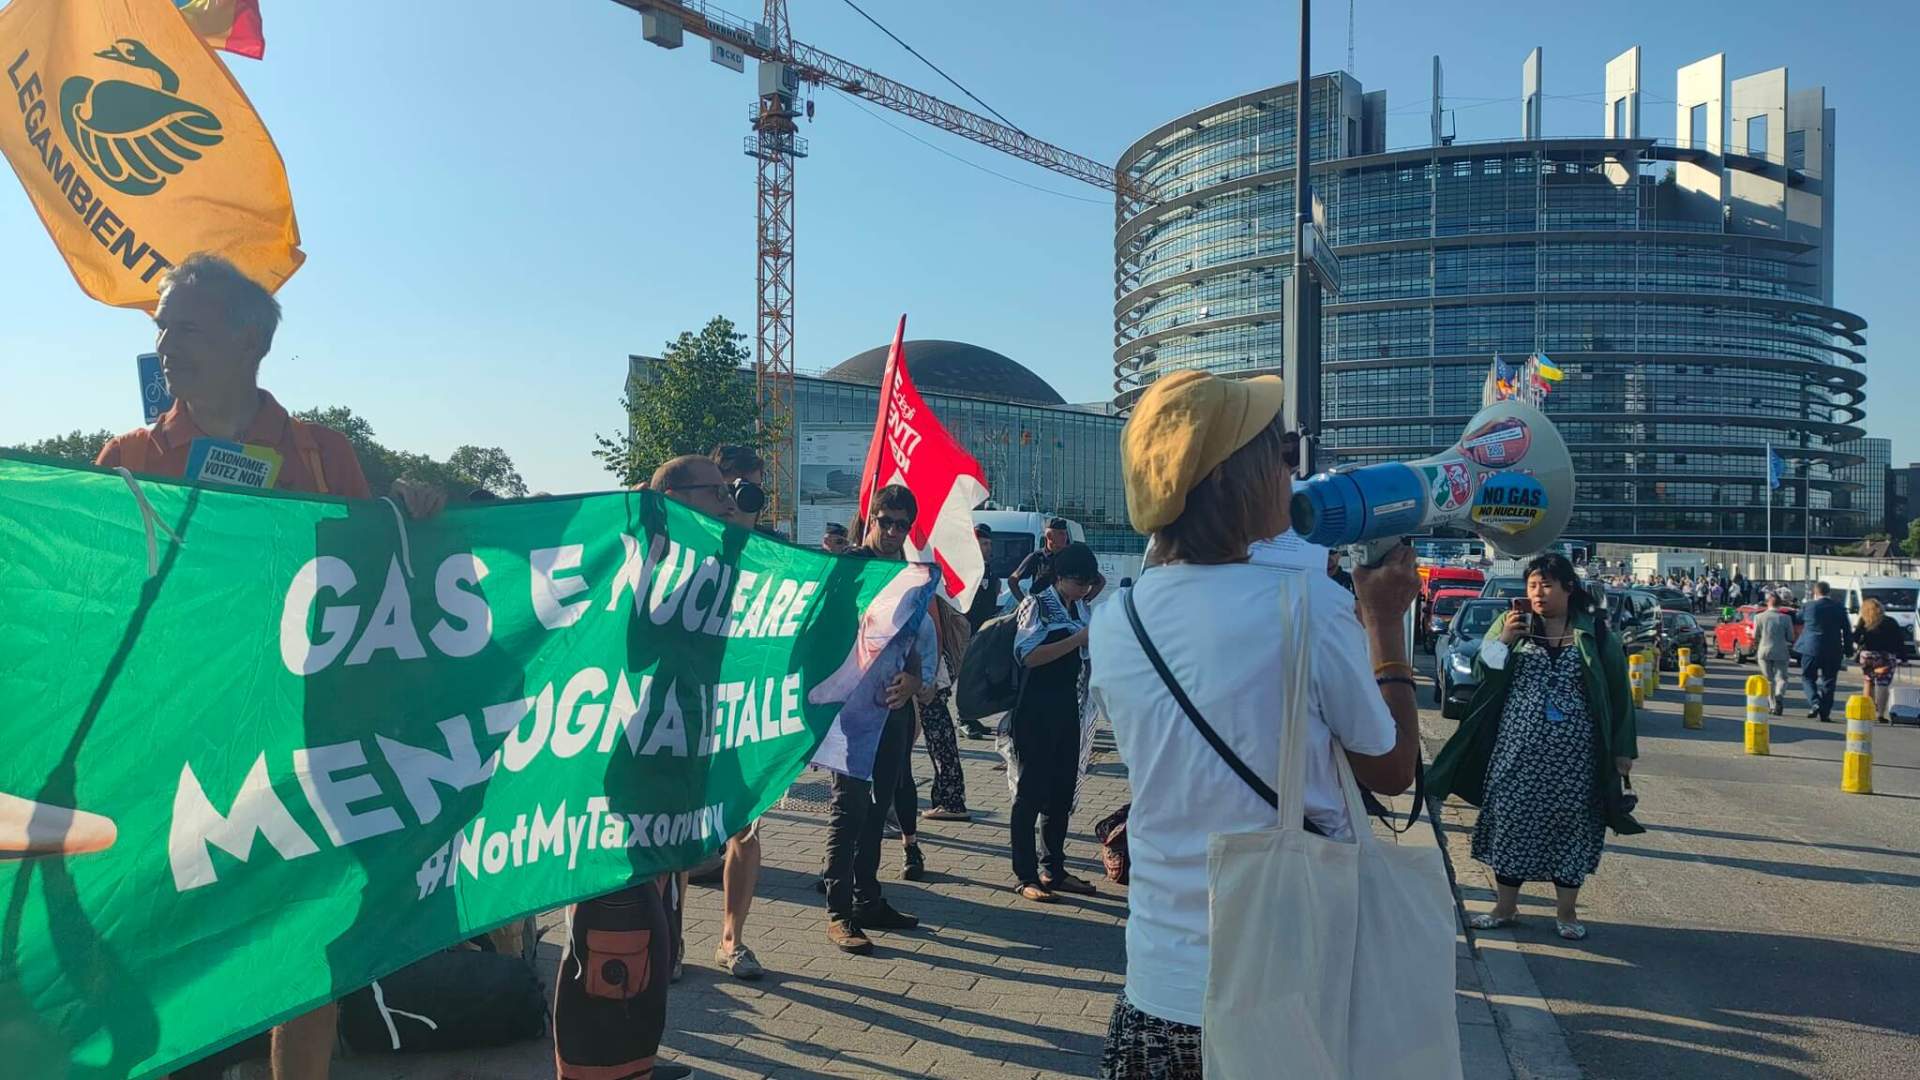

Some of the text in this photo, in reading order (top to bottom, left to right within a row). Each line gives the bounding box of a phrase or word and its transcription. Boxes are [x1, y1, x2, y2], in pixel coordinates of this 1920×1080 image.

[8, 49, 177, 292] LEGAMBIENT
[204, 461, 264, 487] VOTEZ NON
[210, 449, 268, 475] TAXONOMIE:
[1482, 487, 1541, 506] NO GAS
[1479, 506, 1537, 518] NO NUCLEAR
[279, 532, 820, 676] GAS E NUCLEARE
[169, 667, 806, 892] MENZOGNA LETALE
